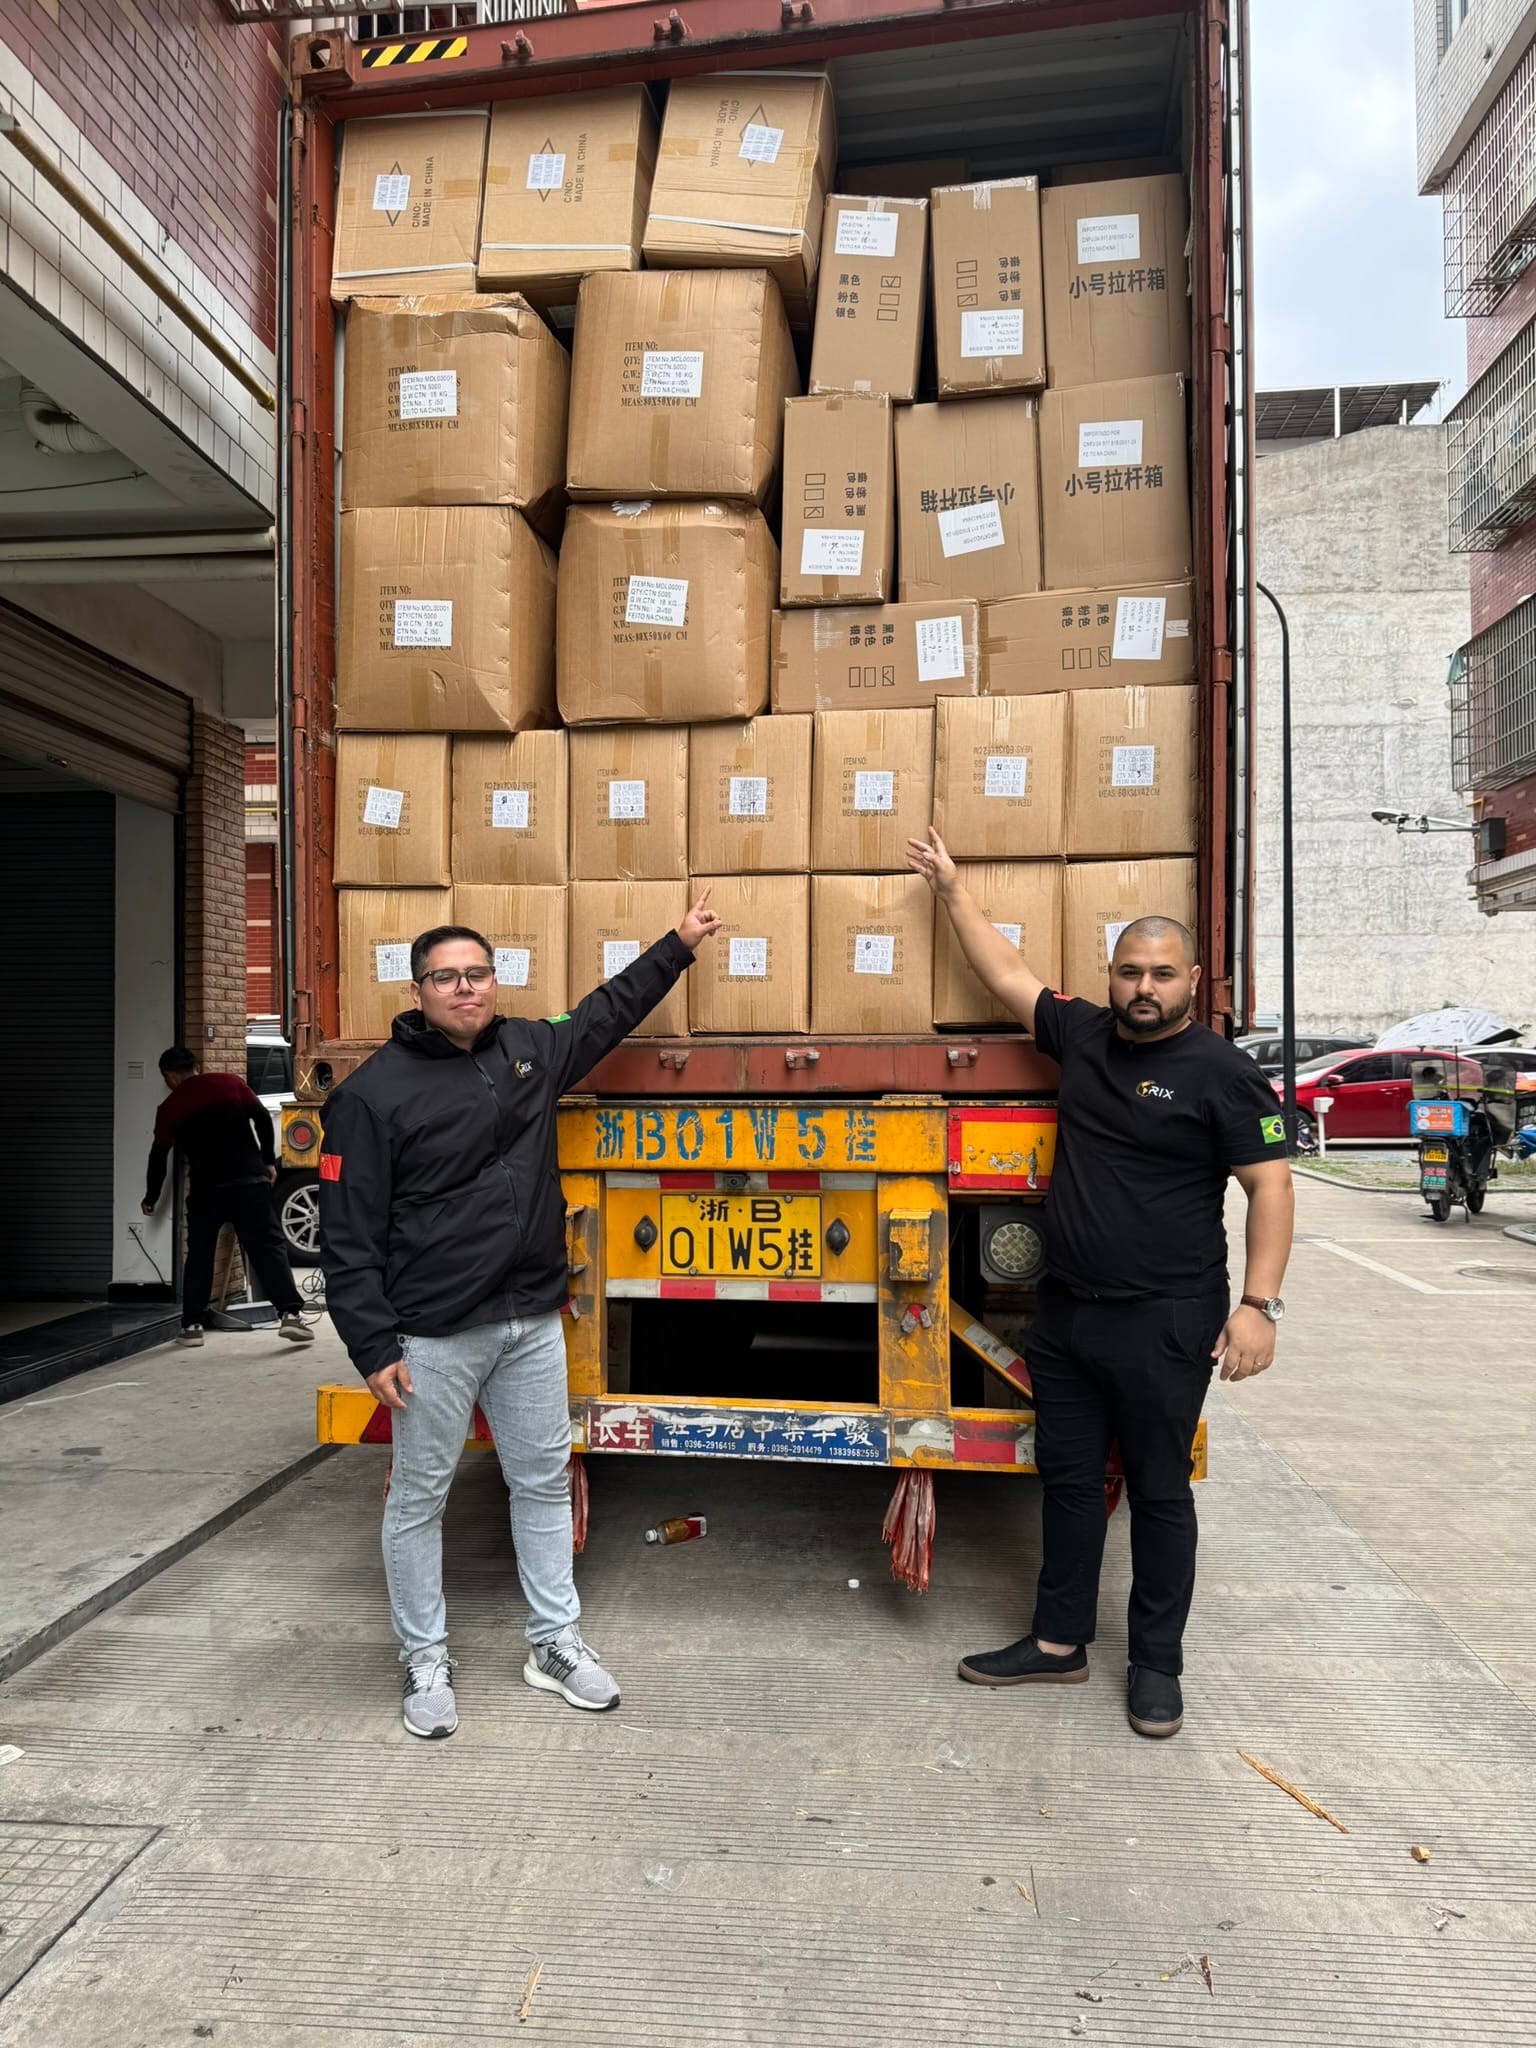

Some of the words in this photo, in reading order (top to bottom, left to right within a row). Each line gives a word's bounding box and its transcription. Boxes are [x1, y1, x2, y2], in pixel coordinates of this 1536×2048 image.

[717, 99, 729, 124] MADE
[715, 128, 724, 136] IN
[577, 133, 587, 160] CHINA
[710, 140, 721, 167] CHINA
[425, 156, 434, 184] CHINA
[576, 165, 584, 173] IN
[424, 188, 432, 197] IN
[564, 178, 574, 203] C/NO:
[575, 177, 584, 202] MADE
[412, 202, 421, 227] C/NO:
[422, 202, 432, 226] MADE
[998, 256, 1020, 268] 银色
[839, 274, 861, 286] 黑色
[998, 271, 1020, 284] 粉色
[1069, 267, 1166, 299] 小号拉杆箱
[838, 291, 859, 303] 粉色
[998, 288, 1021, 302] 黑色
[836, 307, 856, 318] 银色
[625, 342, 643, 352] ITEM
[646, 341, 658, 351] NO:
[624, 356, 640, 367] QTY:
[685, 398, 697, 407] CM
[447, 420, 459, 429] CM
[847, 472, 867, 483] 银色
[1065, 465, 1163, 497] 小号拉杆箱
[844, 487, 867, 498] 粉色
[921, 482, 1015, 513] 小号拉杆箱
[844, 504, 866, 516] 黑色
[380, 586, 397, 595] ITEM
[399, 585, 411, 594] NO:
[628, 612, 645, 620] FEITO
[655, 614, 674, 622] CHINA
[1062, 606, 1073, 628] 银色
[1078, 605, 1091, 628] 粉色
[1097, 604, 1109, 626] 黑色
[676, 631, 688, 640] CM
[850, 624, 861, 646] 银色
[864, 624, 876, 647] 粉色
[882, 624, 894, 646] 黑色
[595, 1109, 877, 1162] 浙B01W5挂
[700, 1199, 782, 1224] 浙·B
[669, 1226, 814, 1271] 01W5挂
